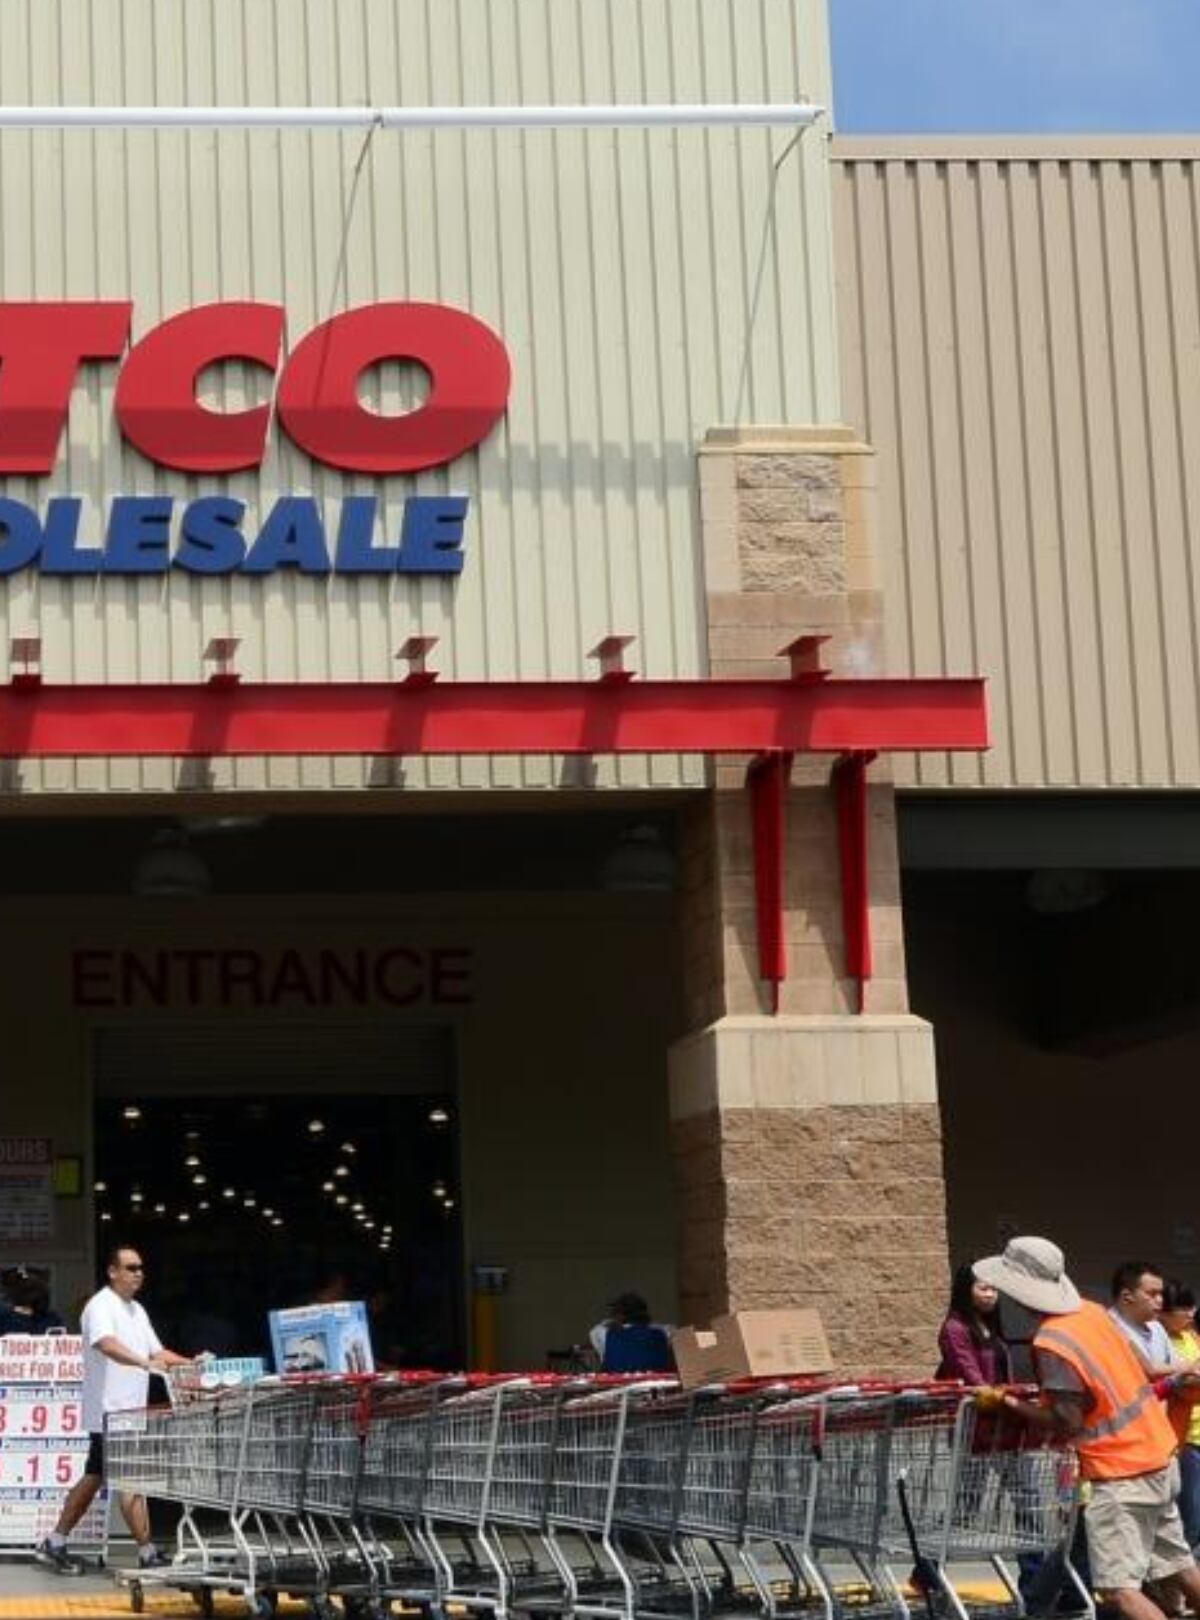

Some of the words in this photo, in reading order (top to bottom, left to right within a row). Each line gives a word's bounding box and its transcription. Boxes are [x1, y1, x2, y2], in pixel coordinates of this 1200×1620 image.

[72, 948, 475, 1006] ENTRANCE
[1, 1339, 50, 1356] TODAY'S
[30, 1360, 54, 1378] FOR
